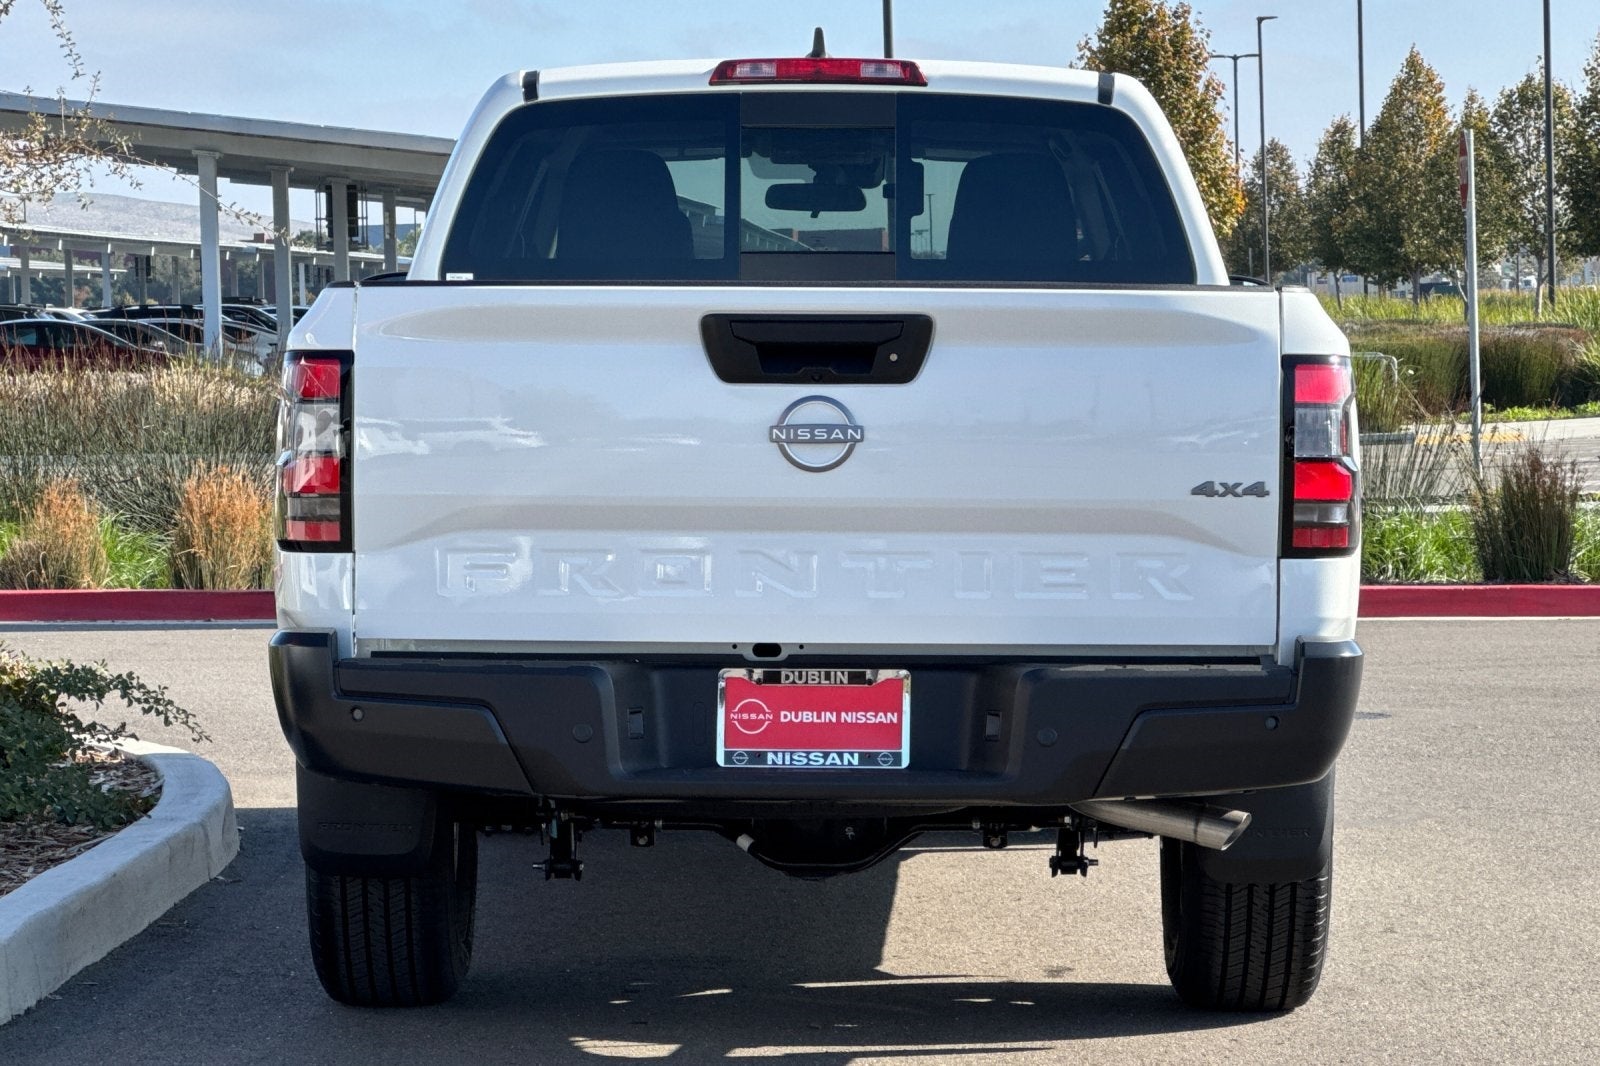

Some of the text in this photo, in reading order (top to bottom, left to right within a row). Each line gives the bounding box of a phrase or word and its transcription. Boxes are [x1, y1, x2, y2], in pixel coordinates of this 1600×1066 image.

[772, 428, 861, 440] NISSAN
[434, 547, 1196, 601] FRONTIER
[780, 670, 849, 685] DUBLIN
[780, 710, 898, 724] DUBLIN NISSAN
[767, 752, 859, 766] NISSAN
